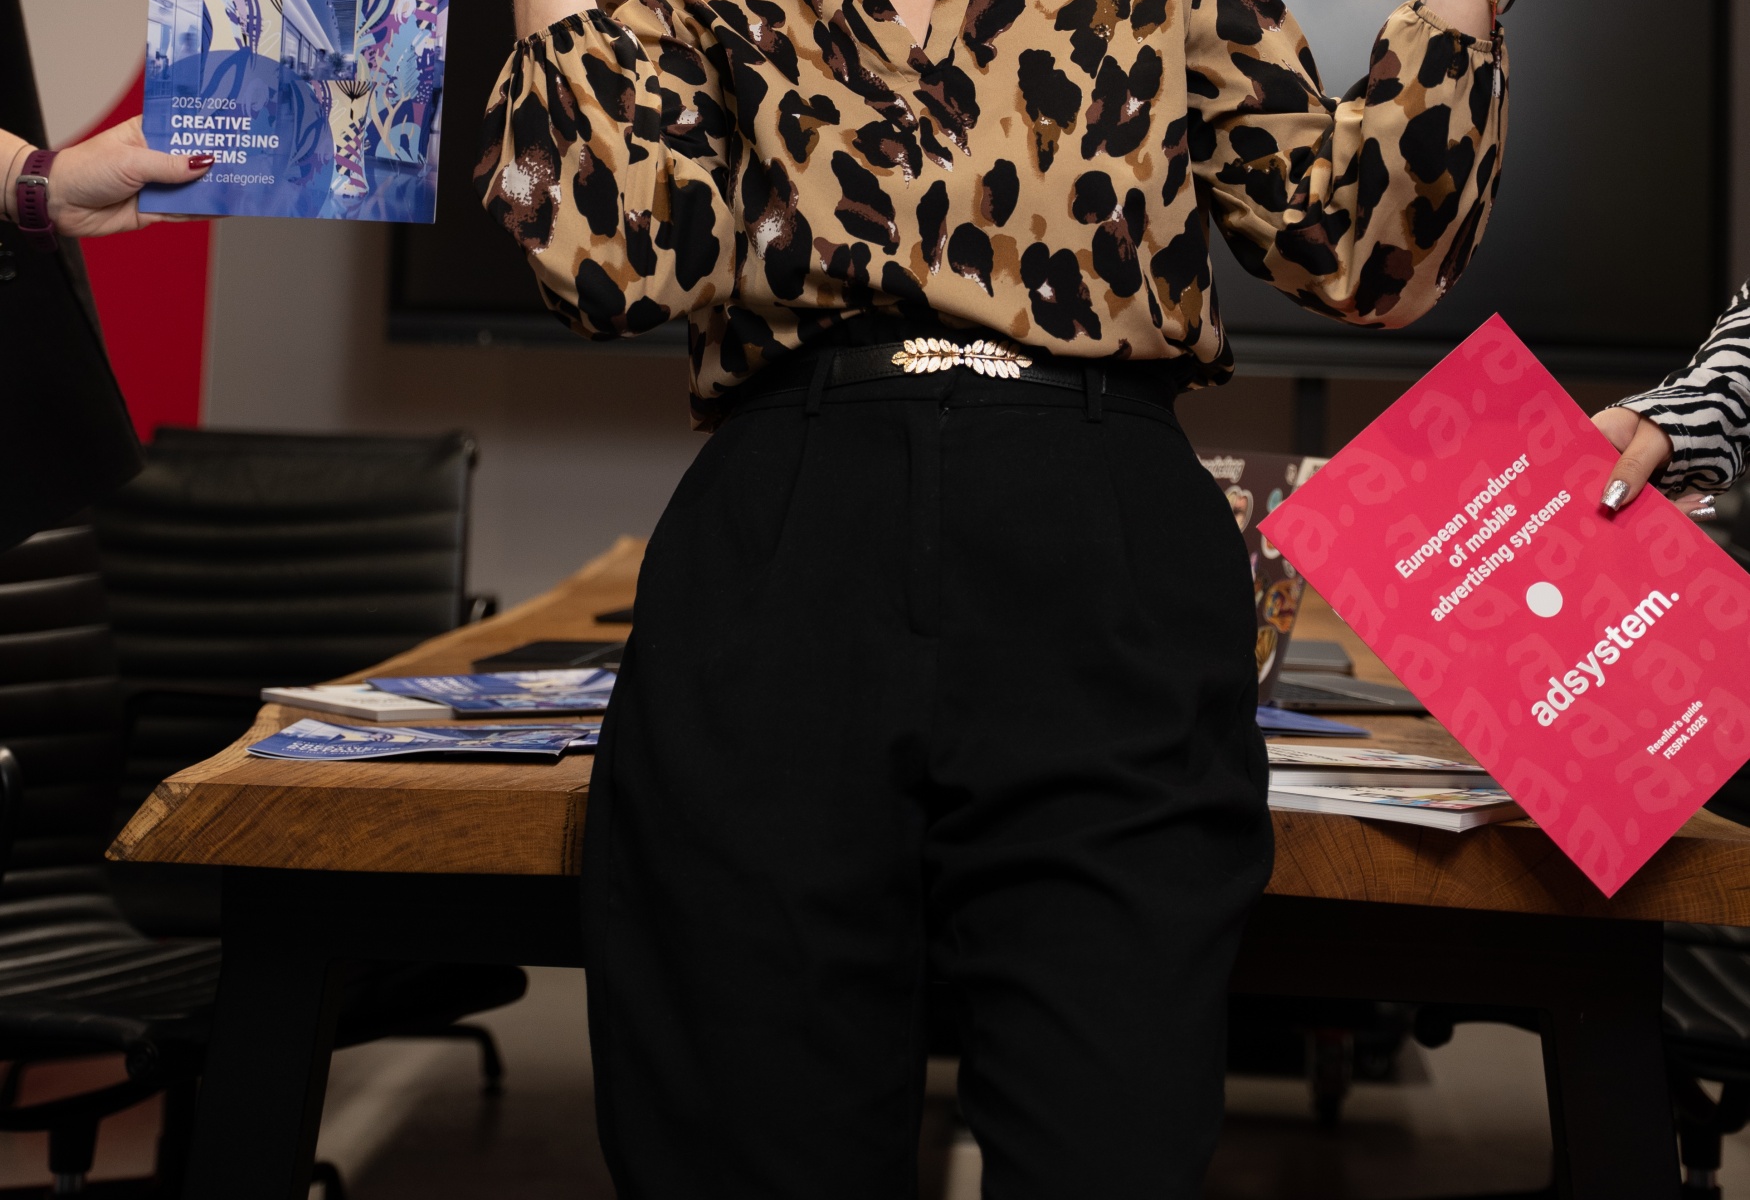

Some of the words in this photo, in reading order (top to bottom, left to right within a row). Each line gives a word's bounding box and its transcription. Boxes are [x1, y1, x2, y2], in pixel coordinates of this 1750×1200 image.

[171, 115, 251, 131] CREATIVE
[172, 96, 237, 110] 2025/2026
[170, 132, 279, 148] ADVERTISING
[216, 172, 275, 186] categories
[1395, 513, 1468, 579] European
[1464, 453, 1530, 520] producer
[1449, 543, 1468, 568] of
[1465, 503, 1518, 553] mobile
[1430, 543, 1515, 622] advertising
[1509, 489, 1571, 548] systems
[1531, 589, 1680, 727] adsystem.
[1646, 720, 1684, 755] Reseller's
[1681, 700, 1704, 723] guide
[1662, 734, 1691, 760] FESPA
[1686, 714, 1708, 737] 2025
